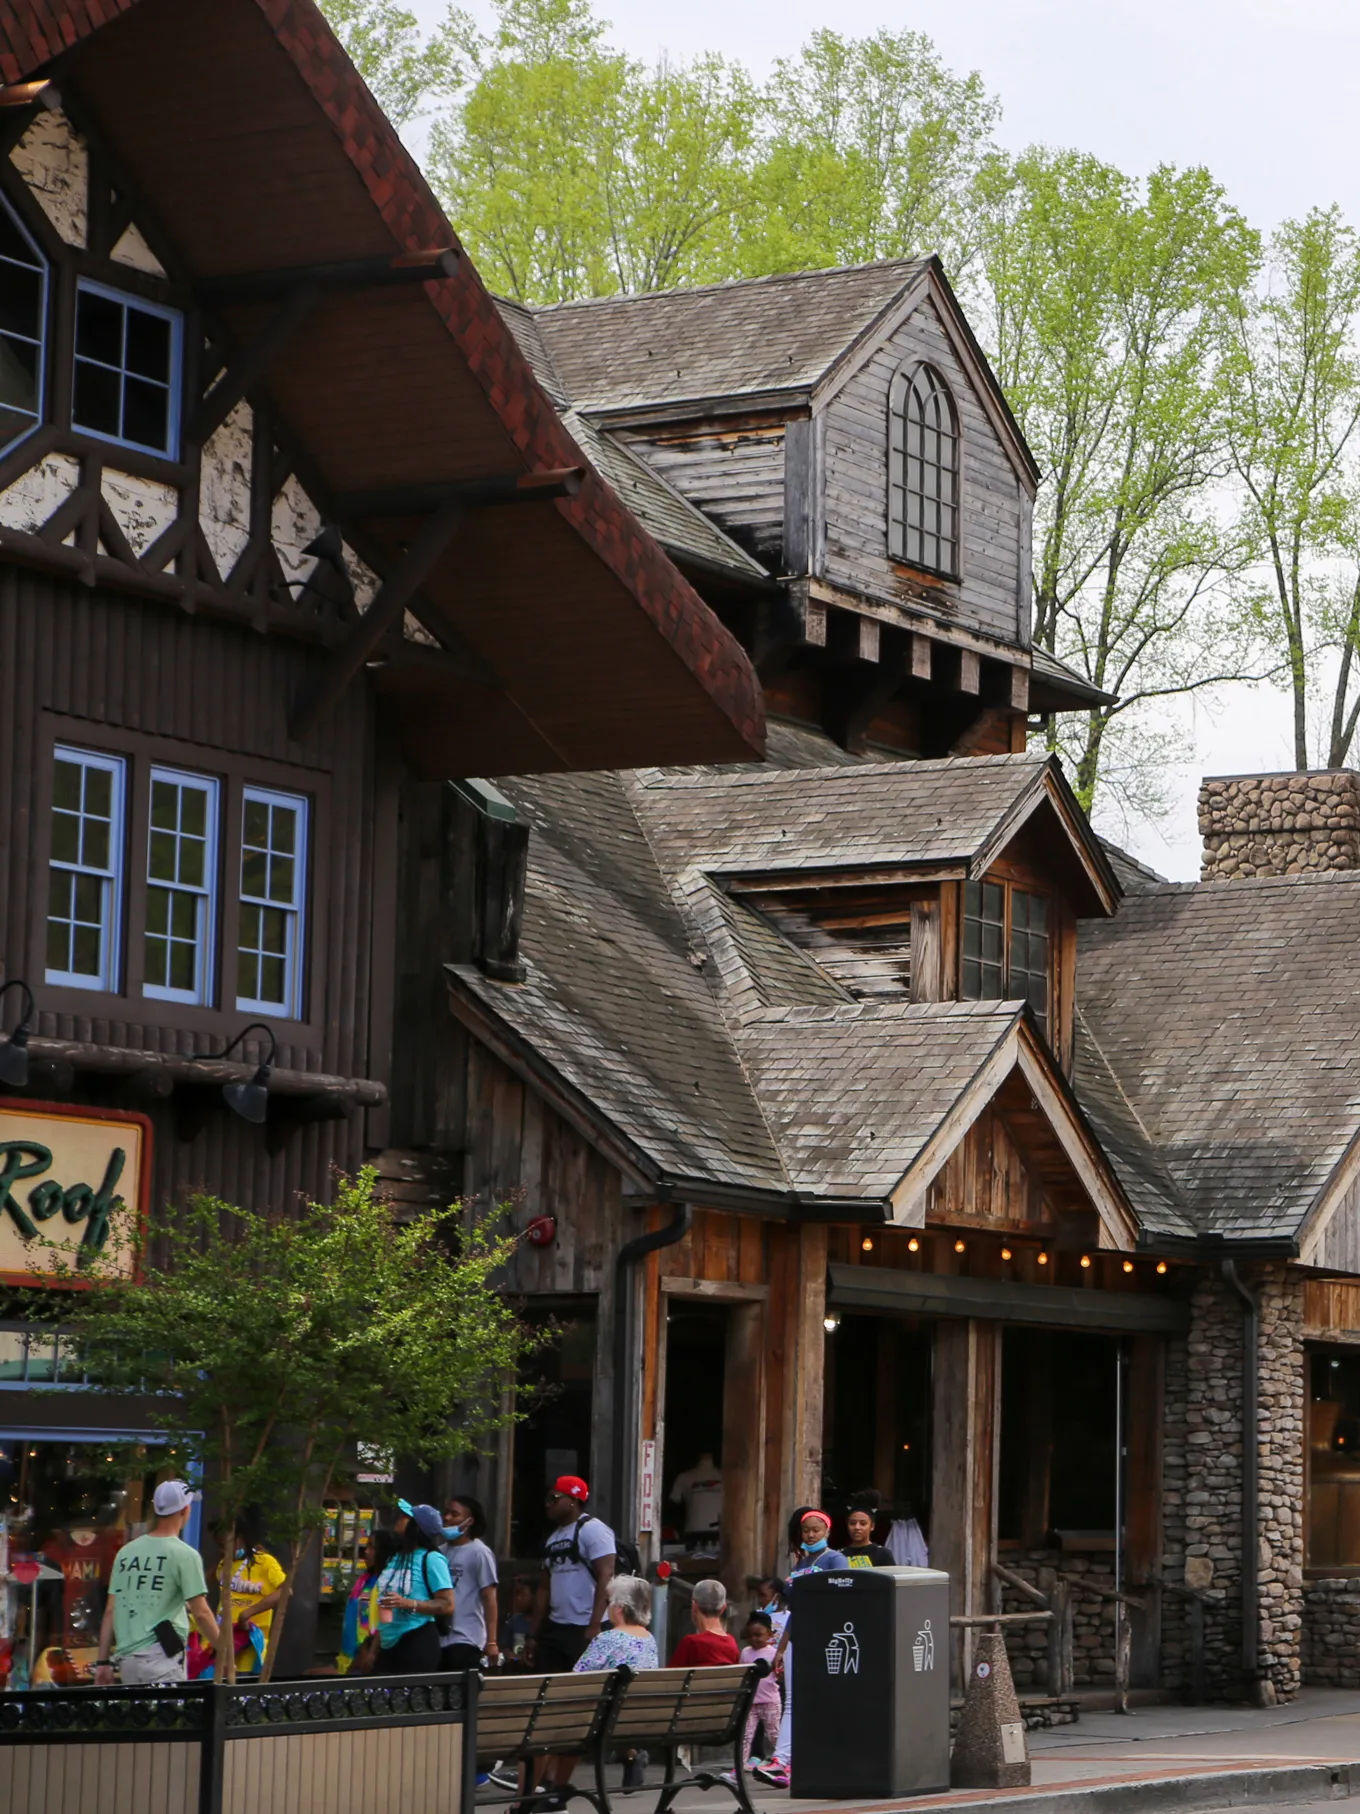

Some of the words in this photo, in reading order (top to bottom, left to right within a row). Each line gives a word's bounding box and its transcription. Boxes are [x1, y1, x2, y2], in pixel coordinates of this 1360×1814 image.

[0, 1140, 126, 1270] Roof
[120, 1556, 167, 1573] SALT
[116, 1575, 165, 1592] IFE
